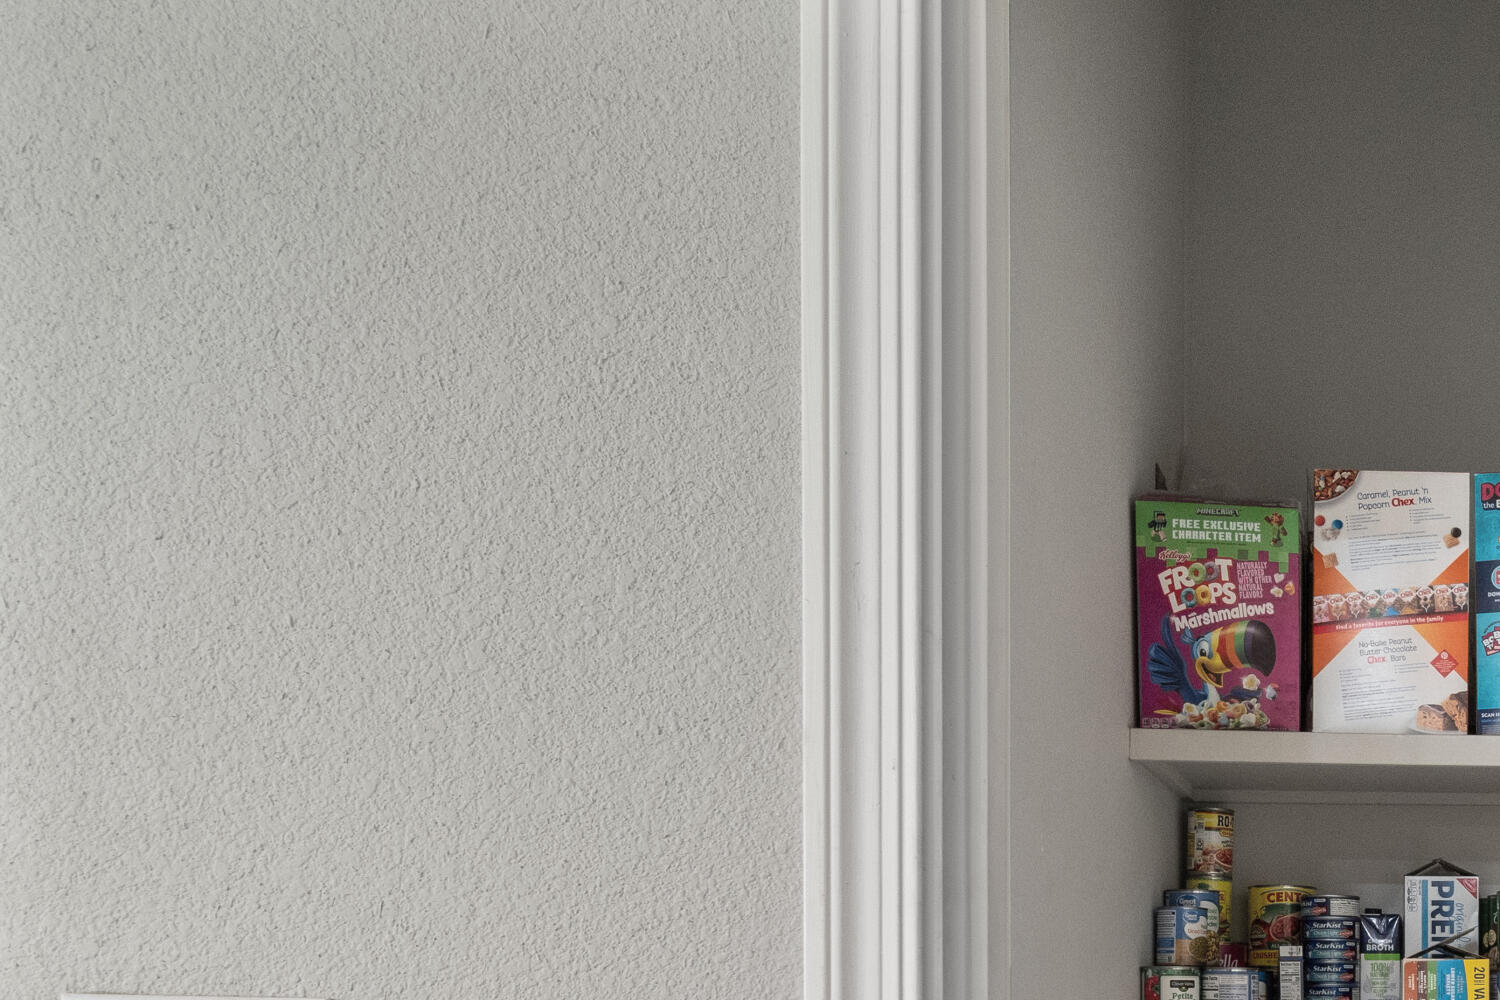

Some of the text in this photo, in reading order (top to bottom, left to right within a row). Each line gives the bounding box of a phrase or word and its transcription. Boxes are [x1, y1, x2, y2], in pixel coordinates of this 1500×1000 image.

[1357, 491, 1390, 500] Caramel,
[1392, 489, 1419, 497] Peanut
[1358, 501, 1390, 510] Popcorn
[1391, 497, 1414, 507] Chex
[1172, 518, 1261, 532] FREE EXCLUSIVE
[1172, 530, 1261, 543] CHARACTER ITEM
[1159, 550, 1192, 562] Kellogg's
[1158, 558, 1232, 595] FROOT
[1255, 575, 1272, 583] OTHER
[1168, 583, 1236, 613] LOOPS
[1174, 602, 1274, 632] Marshmallows
[1427, 615, 1443, 623] family
[1383, 645, 1417, 653] Chocolate
[1474, 967, 1485, 982] 20
[1172, 992, 1193, 1000] Petite
